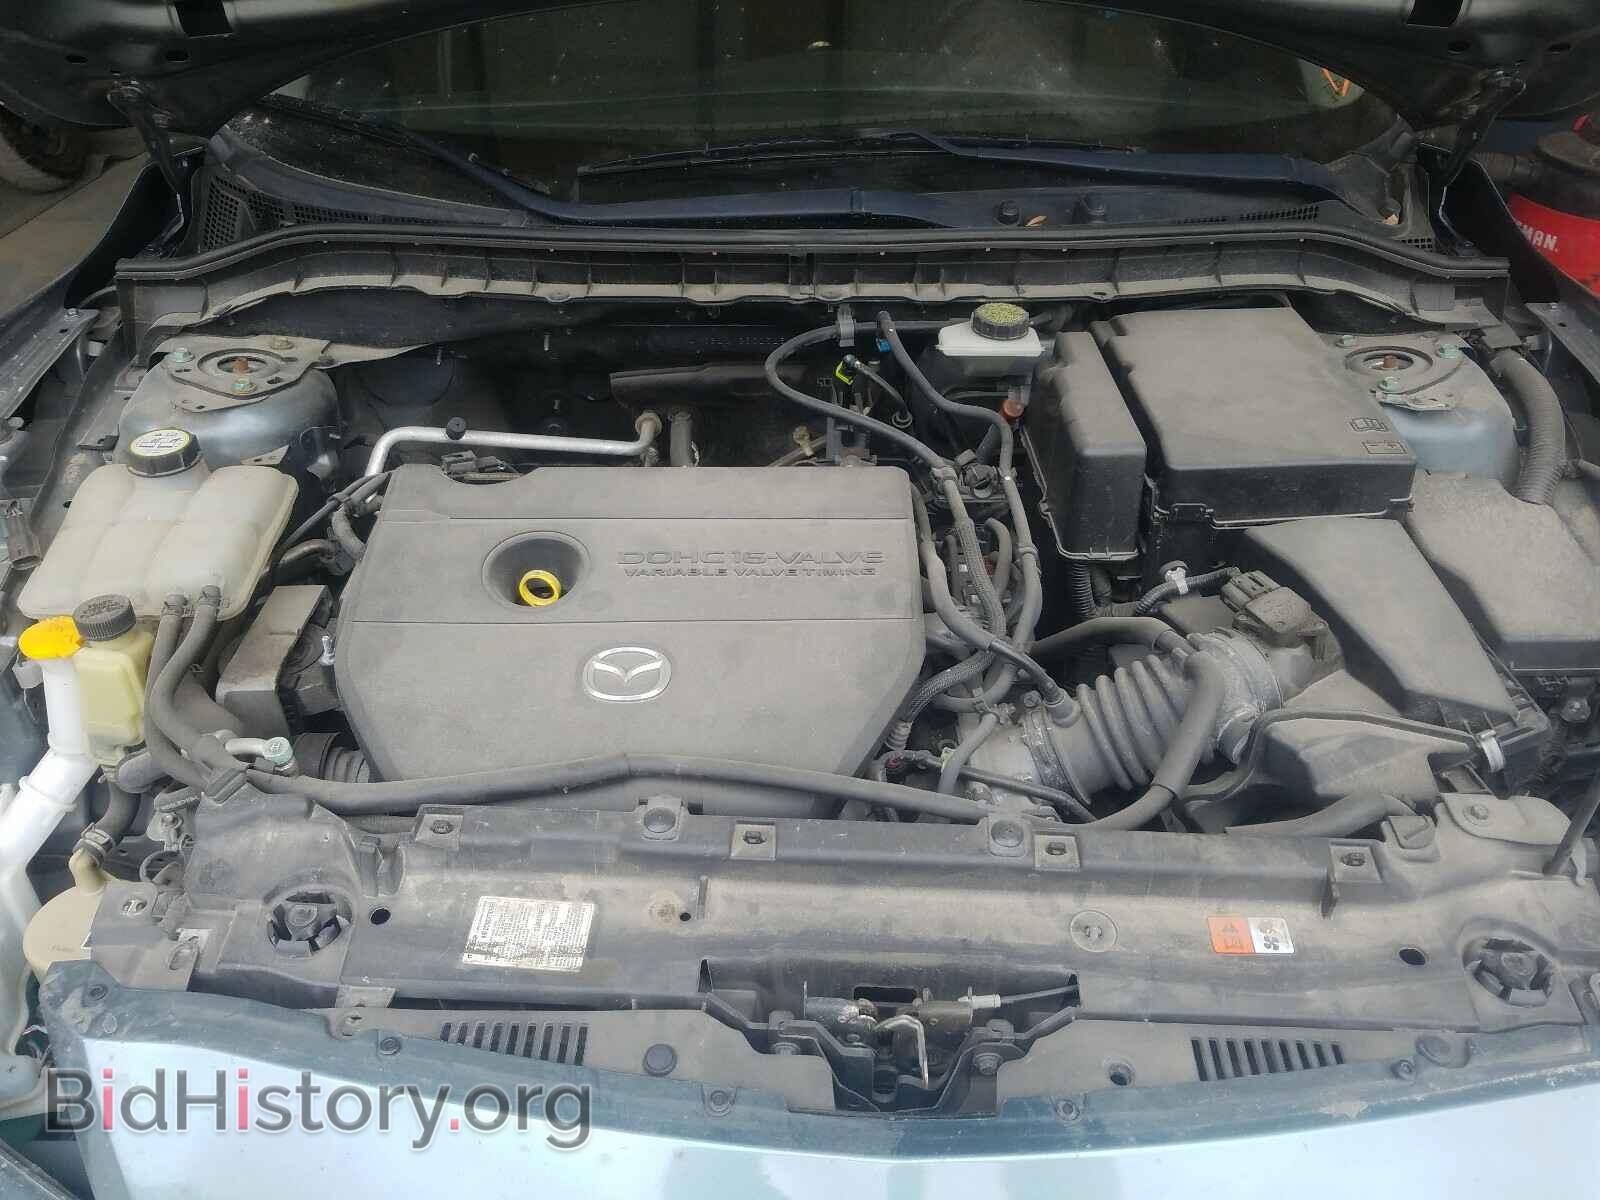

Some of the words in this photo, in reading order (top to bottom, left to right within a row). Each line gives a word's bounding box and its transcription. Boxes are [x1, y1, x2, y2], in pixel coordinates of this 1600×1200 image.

[616, 551, 725, 565] DOHC
[623, 567, 728, 577] VARIABLE
[733, 567, 799, 577] VALVE
[801, 567, 877, 577] TIMING
